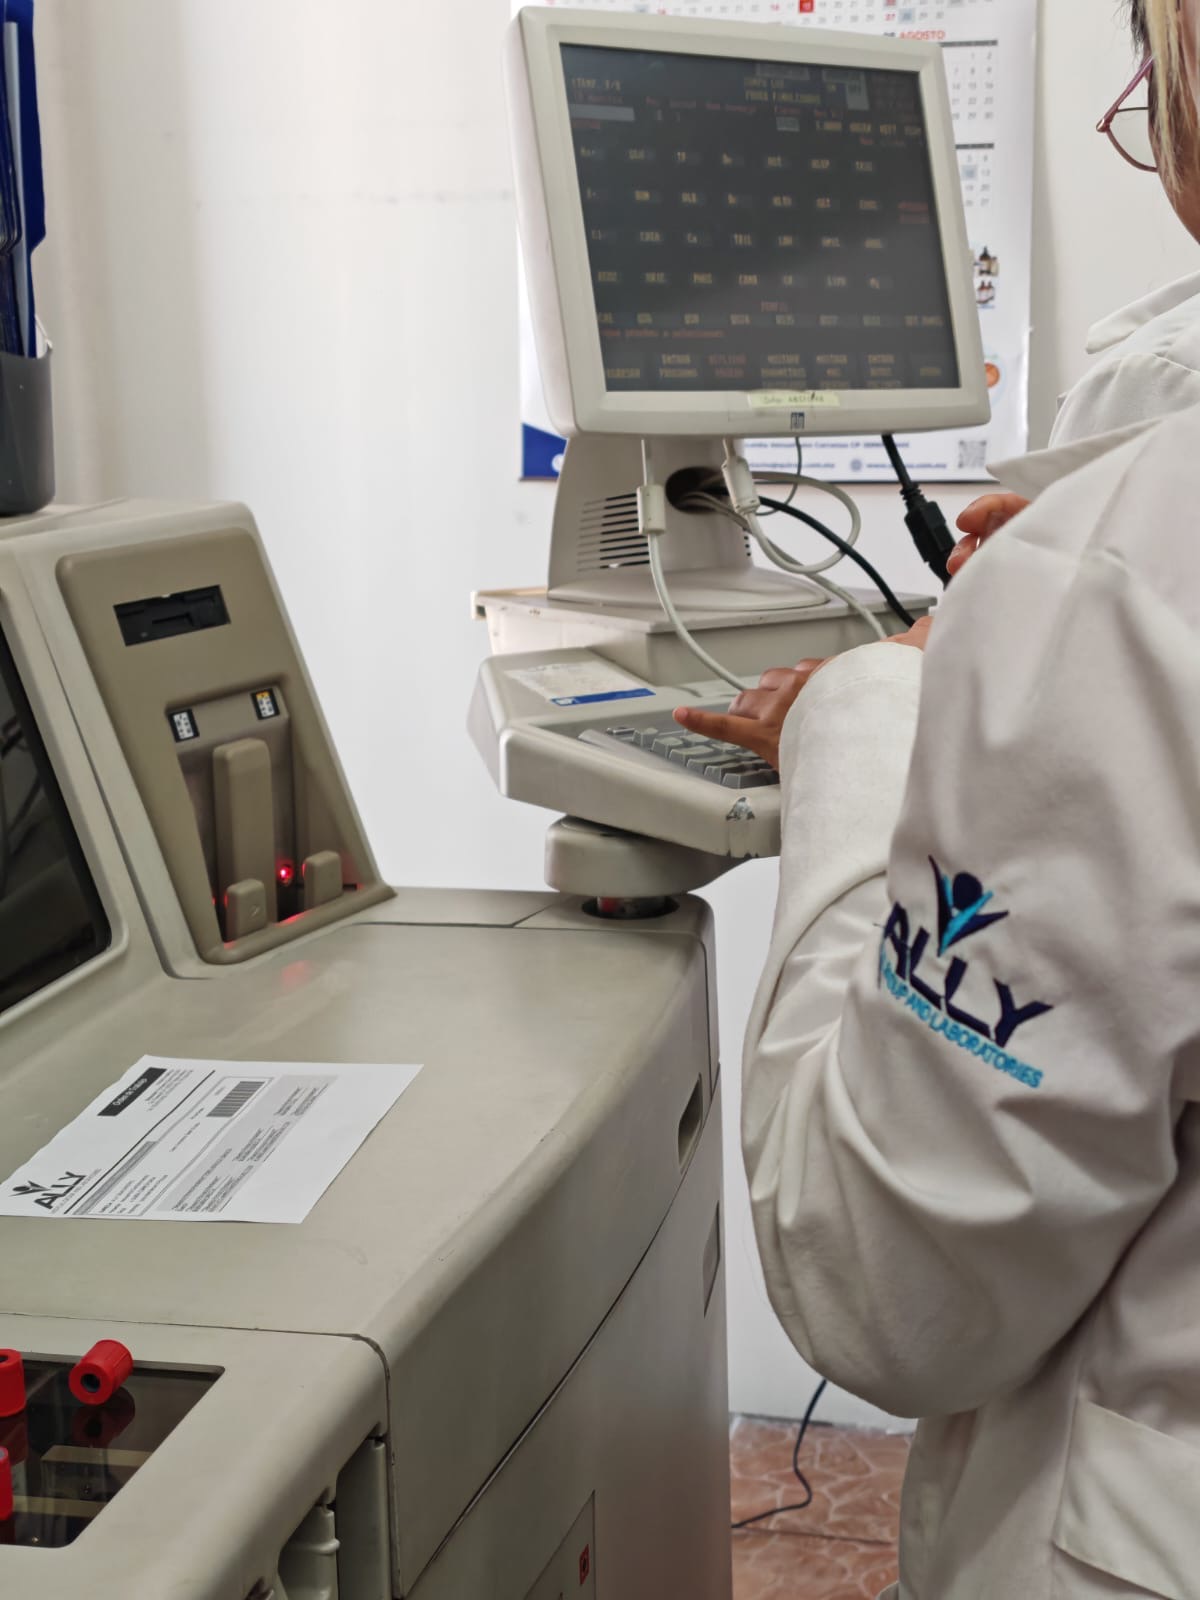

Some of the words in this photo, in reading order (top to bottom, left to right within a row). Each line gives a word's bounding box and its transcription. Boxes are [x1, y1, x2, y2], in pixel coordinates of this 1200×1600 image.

[900, 30, 946, 40] AGOSTO
[878, 900, 1054, 1049] ALLY
[929, 1011, 1045, 1089] LABORATORIES
[34, 1171, 87, 1210] ALLY
